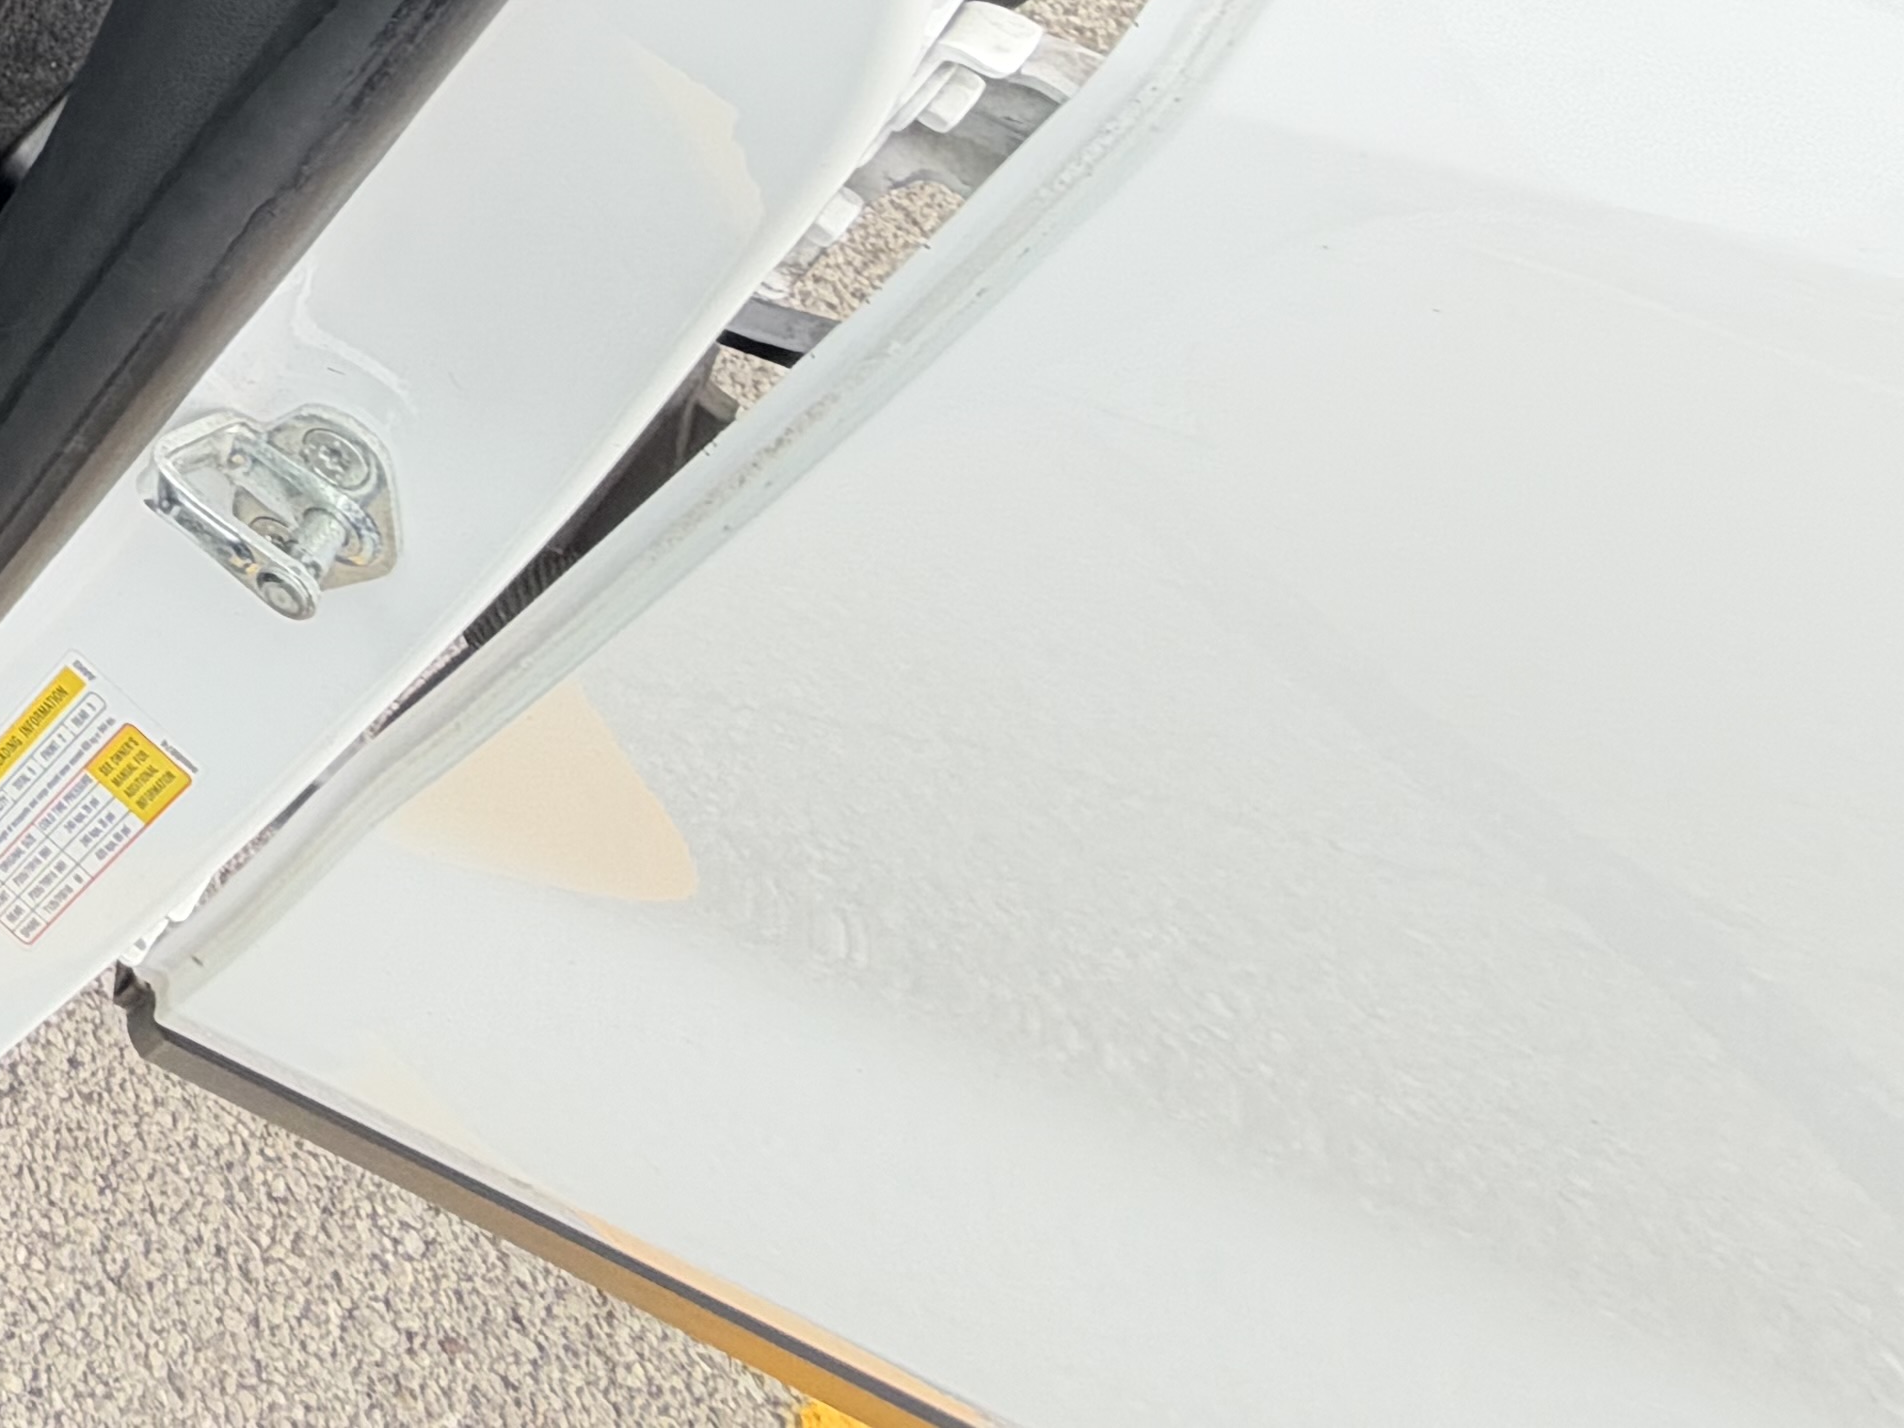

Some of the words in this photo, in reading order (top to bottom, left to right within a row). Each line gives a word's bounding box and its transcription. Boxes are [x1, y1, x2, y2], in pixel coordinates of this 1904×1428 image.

[19, 686, 68, 737] INFORMATION
[98, 761, 114, 777] SEE
[110, 736, 139, 765] OWNER'S
[132, 750, 149, 765] FOR
[136, 771, 176, 810] INFORMATION
